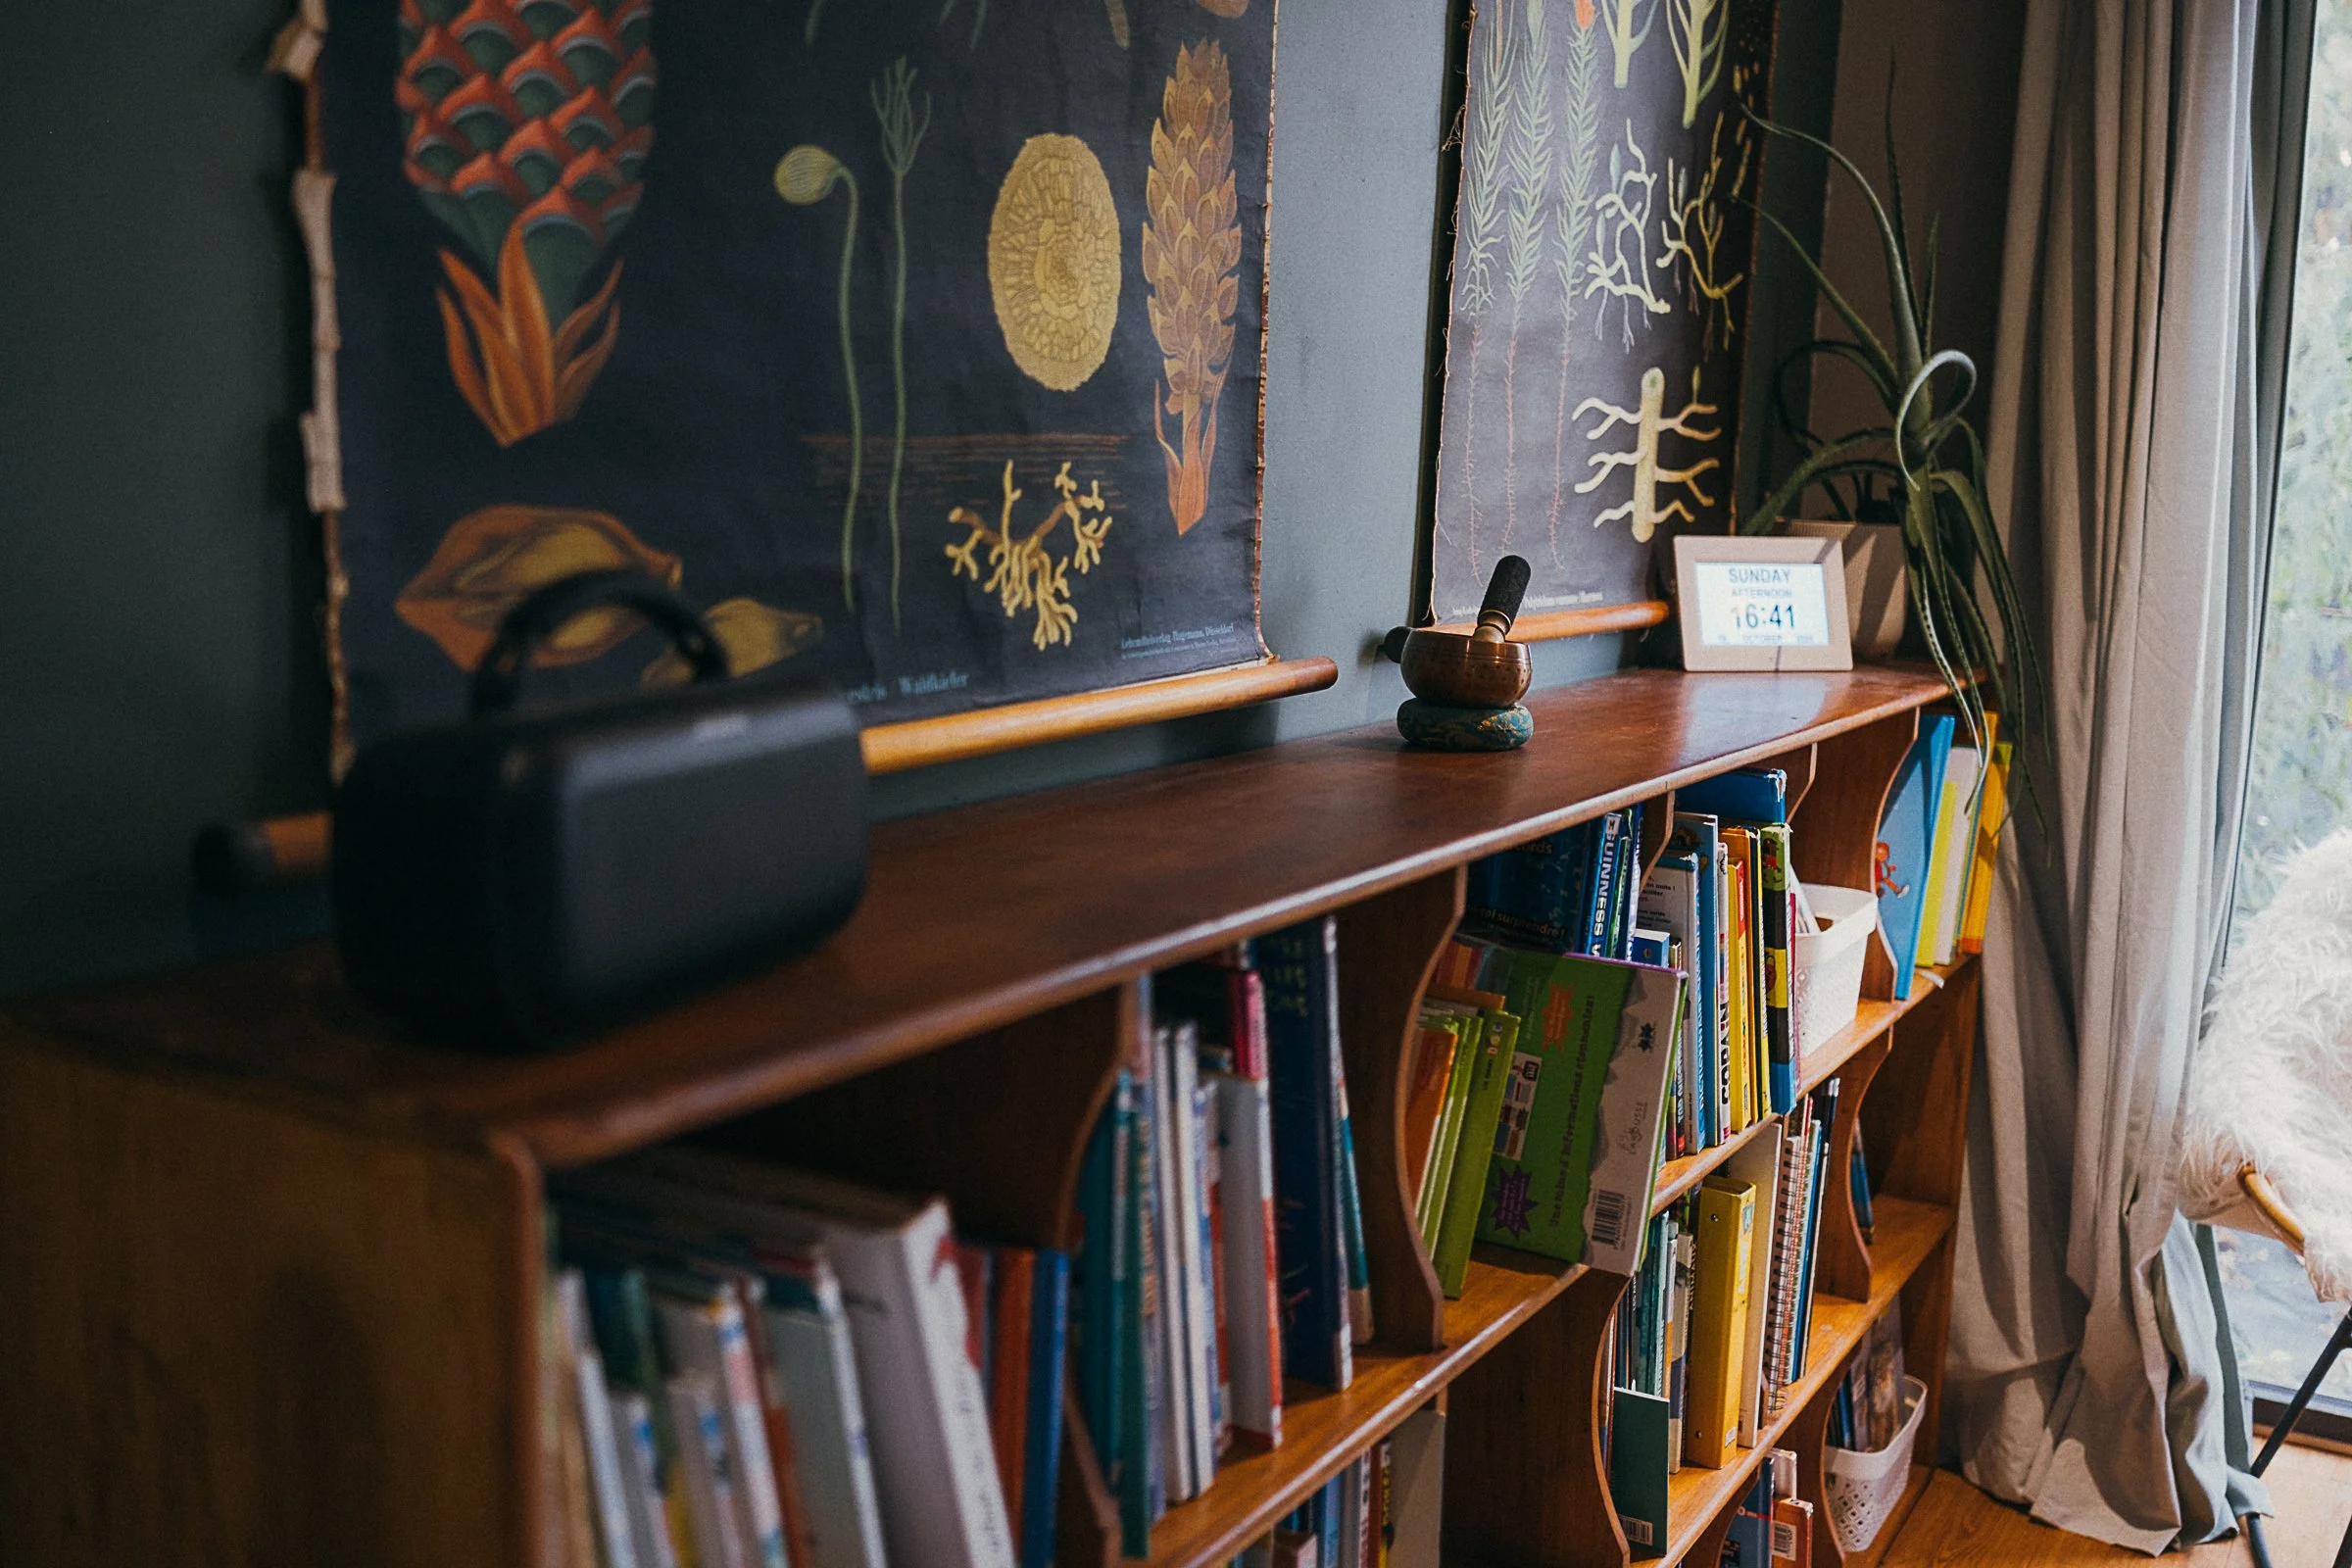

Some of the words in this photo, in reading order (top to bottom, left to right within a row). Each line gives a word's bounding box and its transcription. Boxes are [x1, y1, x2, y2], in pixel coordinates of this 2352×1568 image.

[1729, 568, 1791, 583] SUNDAY
[1732, 588, 1792, 598] AFTERNOON
[1731, 604, 1794, 628] 16:41
[1593, 831, 1616, 937] GUINNESS
